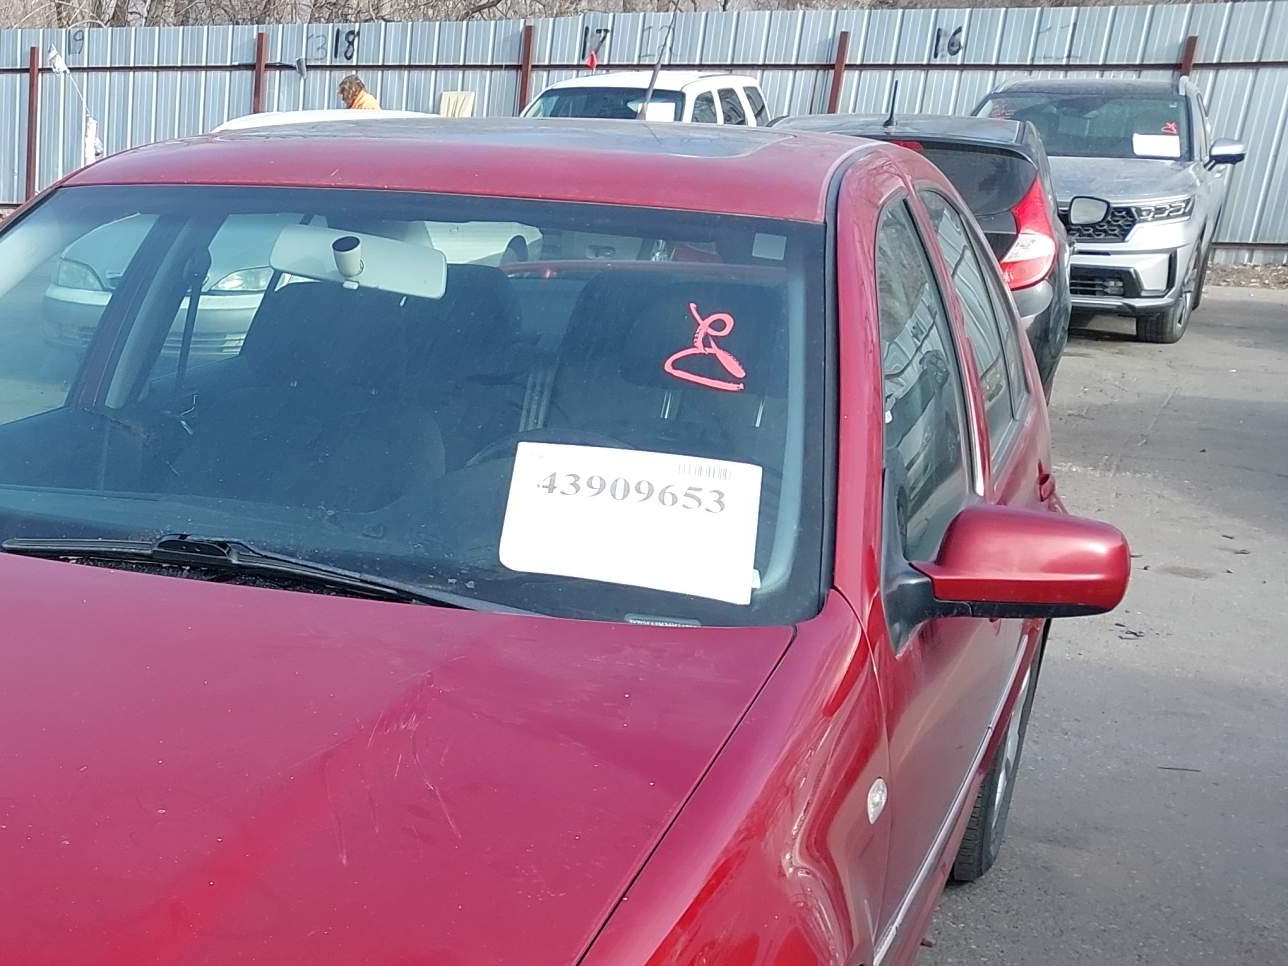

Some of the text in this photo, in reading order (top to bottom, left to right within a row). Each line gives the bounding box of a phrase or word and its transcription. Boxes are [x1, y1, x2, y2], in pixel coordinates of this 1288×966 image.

[67, 29, 85, 56] 19
[333, 27, 360, 60] 18
[582, 25, 610, 60] 17
[933, 25, 963, 59] 16
[536, 471, 726, 514] 43909653
